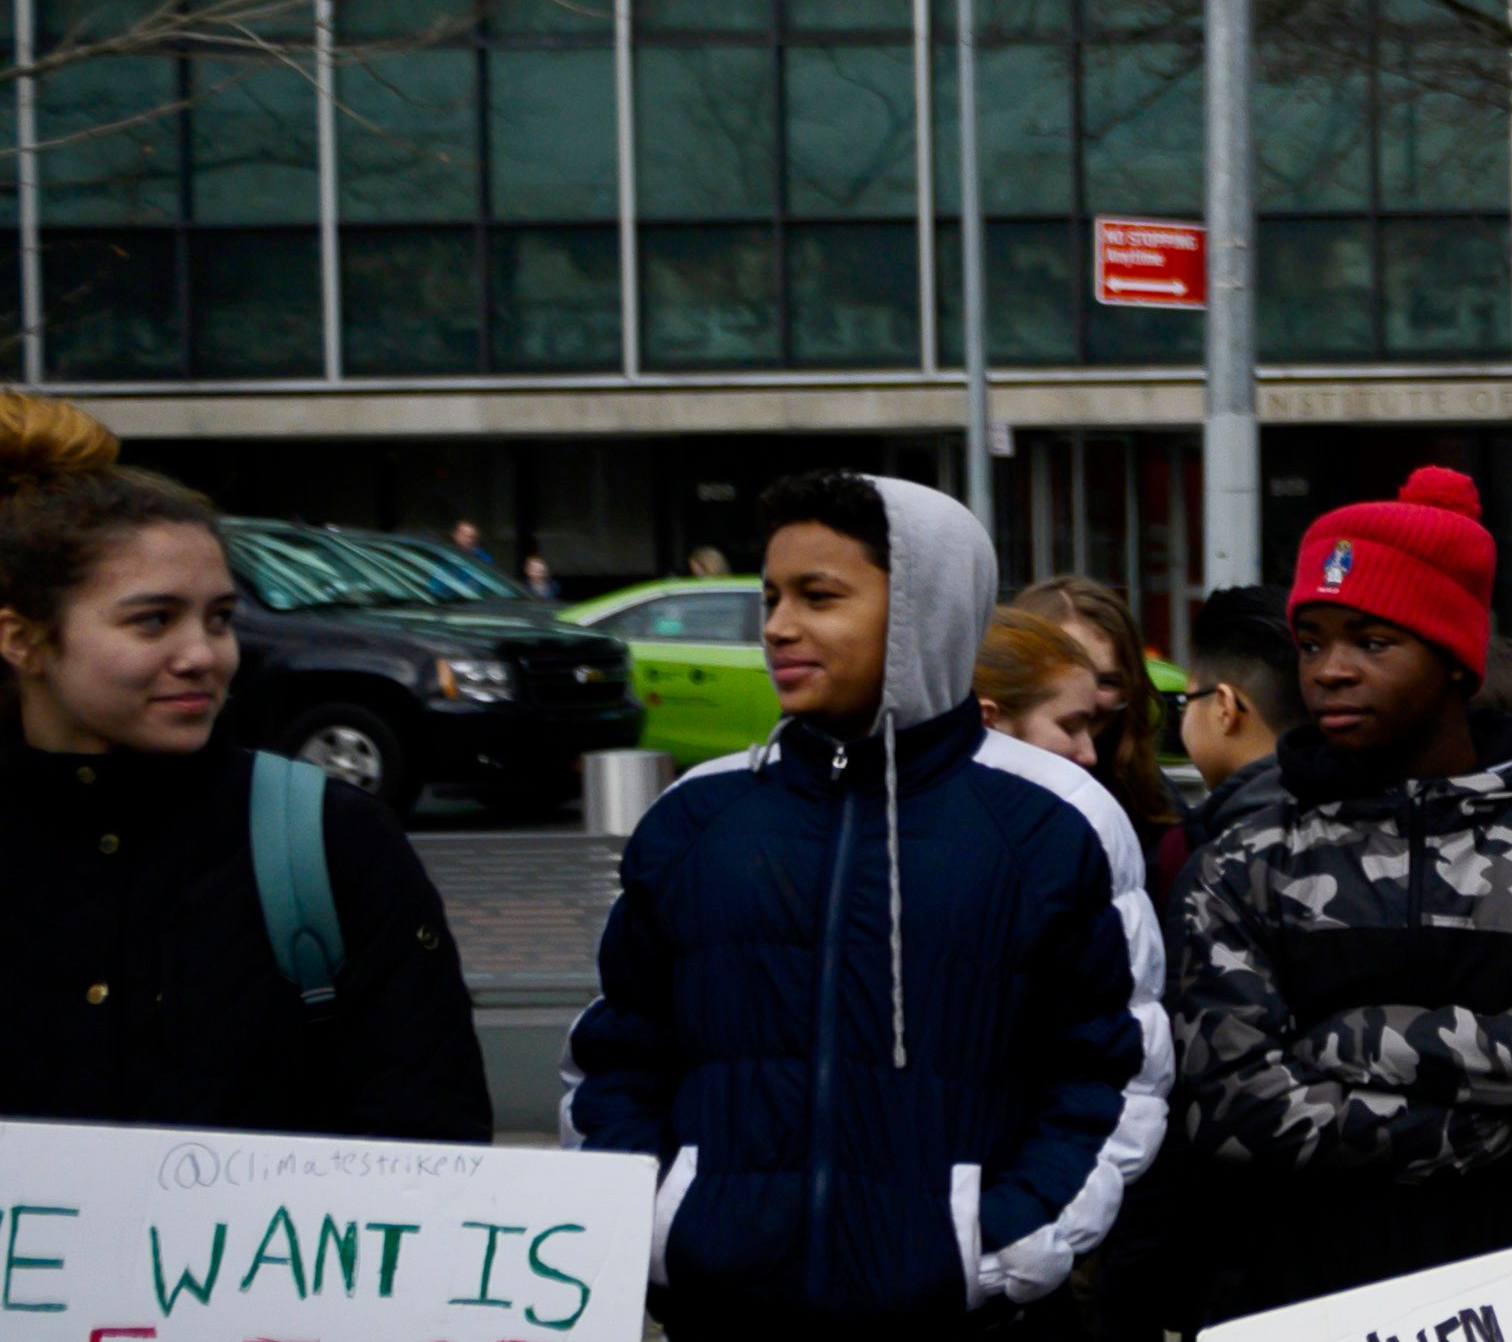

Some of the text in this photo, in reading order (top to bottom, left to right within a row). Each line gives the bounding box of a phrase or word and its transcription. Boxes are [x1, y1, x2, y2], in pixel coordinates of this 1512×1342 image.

[0, 1204, 591, 1331] E WANT IS
